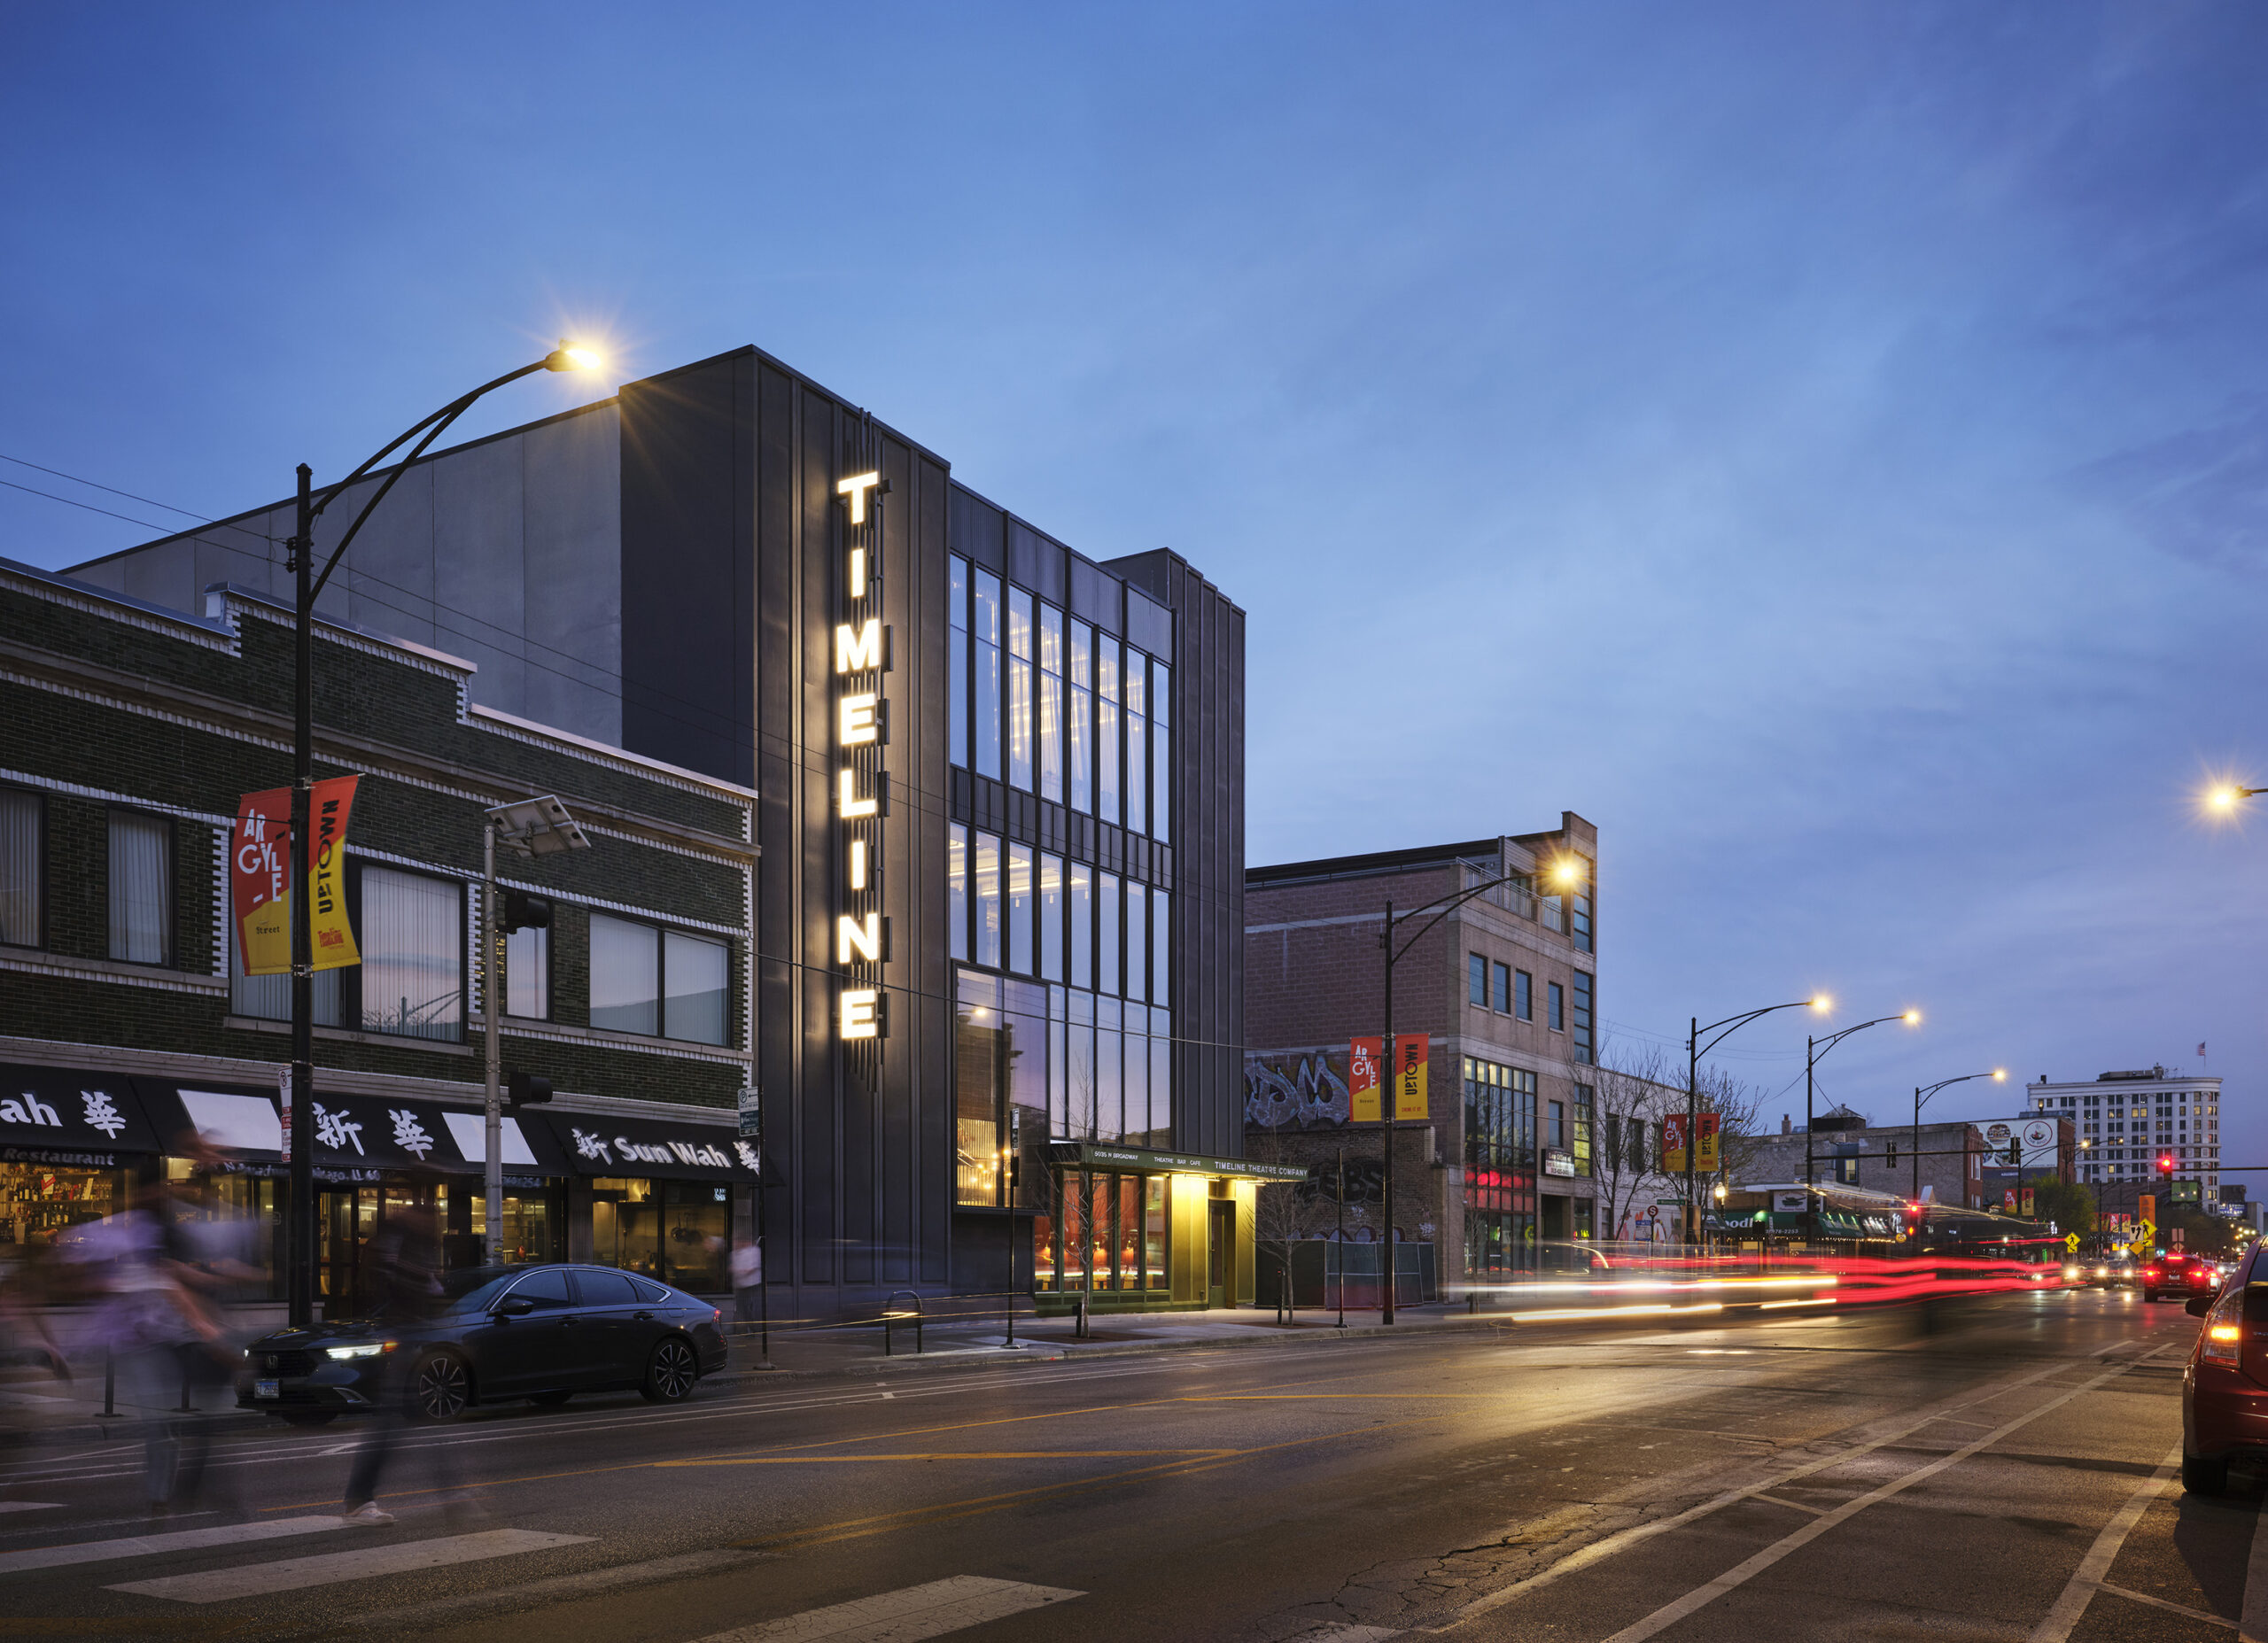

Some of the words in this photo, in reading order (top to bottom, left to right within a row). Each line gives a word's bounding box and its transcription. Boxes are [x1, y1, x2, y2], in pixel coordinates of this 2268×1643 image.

[836, 471, 880, 1039] TIMELINE
[237, 809, 282, 902] ARGYLE
[318, 799, 339, 915] UPTOWN
[255, 926, 281, 935] Street
[1352, 1044, 1376, 1089] ARGYLE
[1405, 1043, 1418, 1096] UPTOWN
[0, 1093, 63, 1127] ah
[82, 1090, 127, 1139] 華
[4, 1148, 114, 1166] Restaurant
[614, 1137, 675, 1164] Sun
[666, 1141, 734, 1168] Wah
[1702, 1120, 1712, 1155] UPTOWN
[1215, 1161, 1246, 1172] TIMELINE
[1248, 1164, 1277, 1174] THEATRE
[1278, 1166, 1308, 1177] COMPANY
